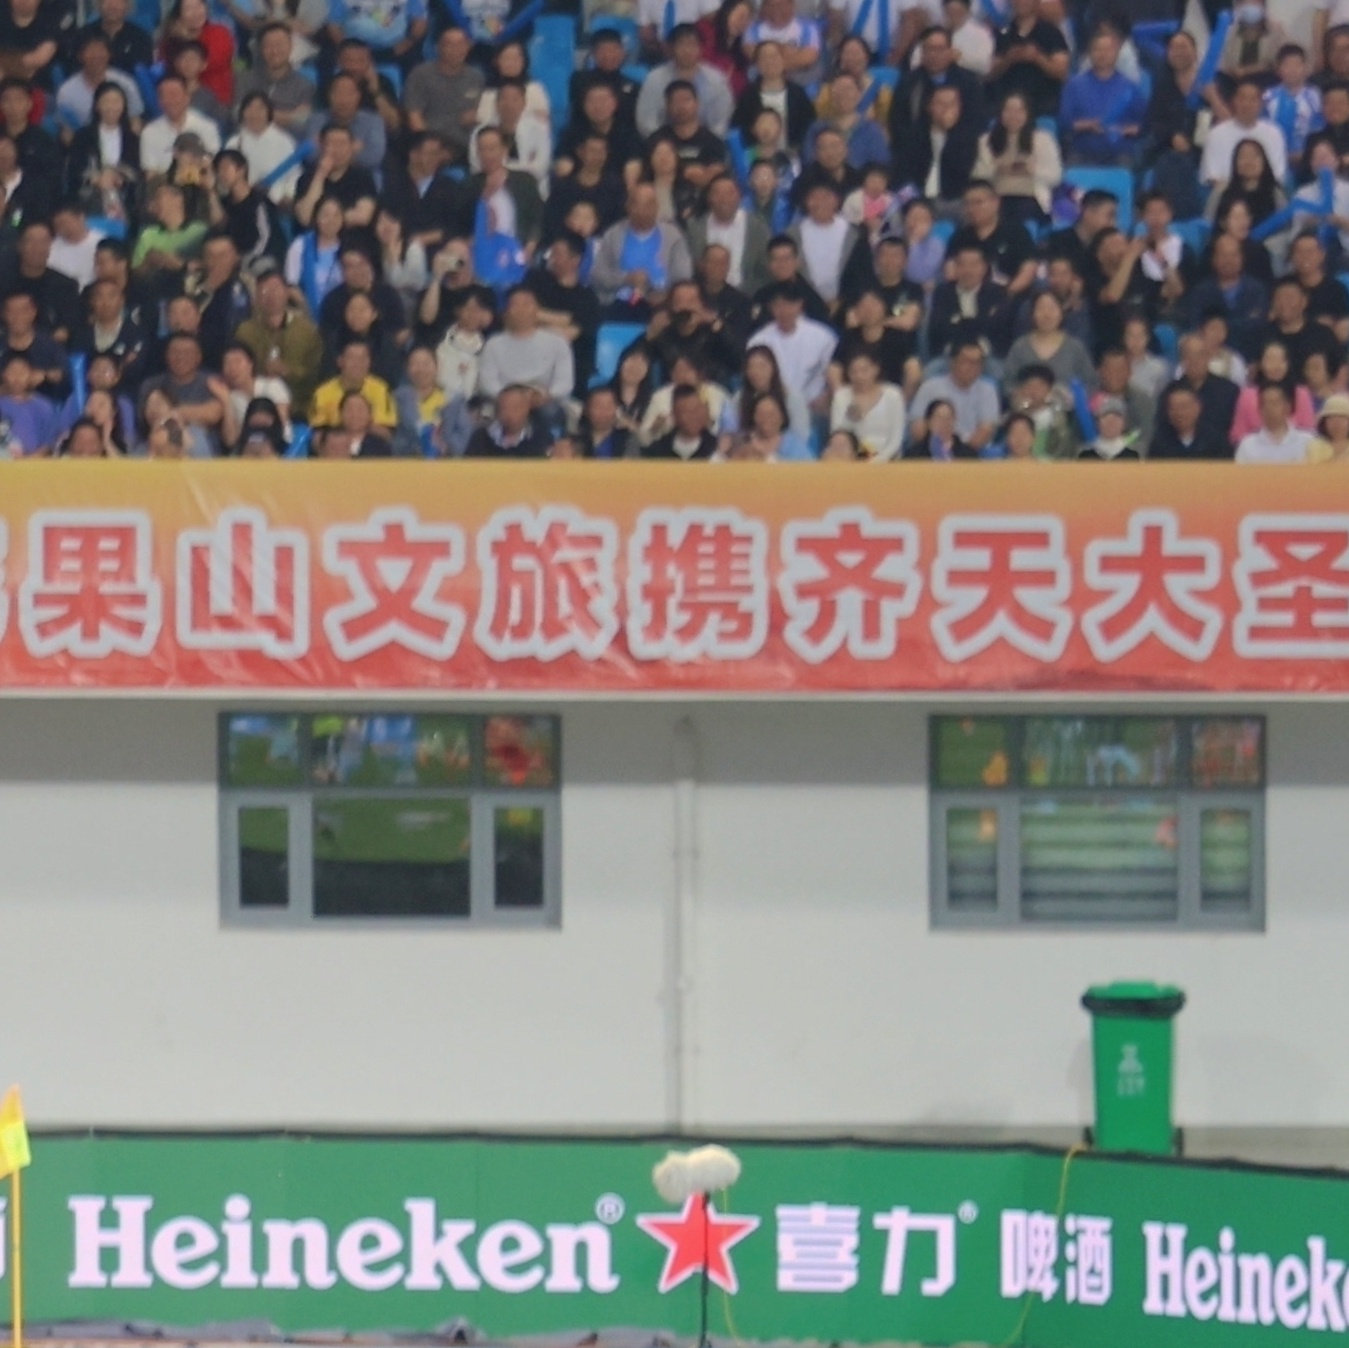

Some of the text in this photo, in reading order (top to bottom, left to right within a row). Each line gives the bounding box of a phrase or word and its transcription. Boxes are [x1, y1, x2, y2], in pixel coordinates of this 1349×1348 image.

[68, 1194, 620, 1293] Heineken
[775, 1203, 1113, 1305] 喜力 啤酒
